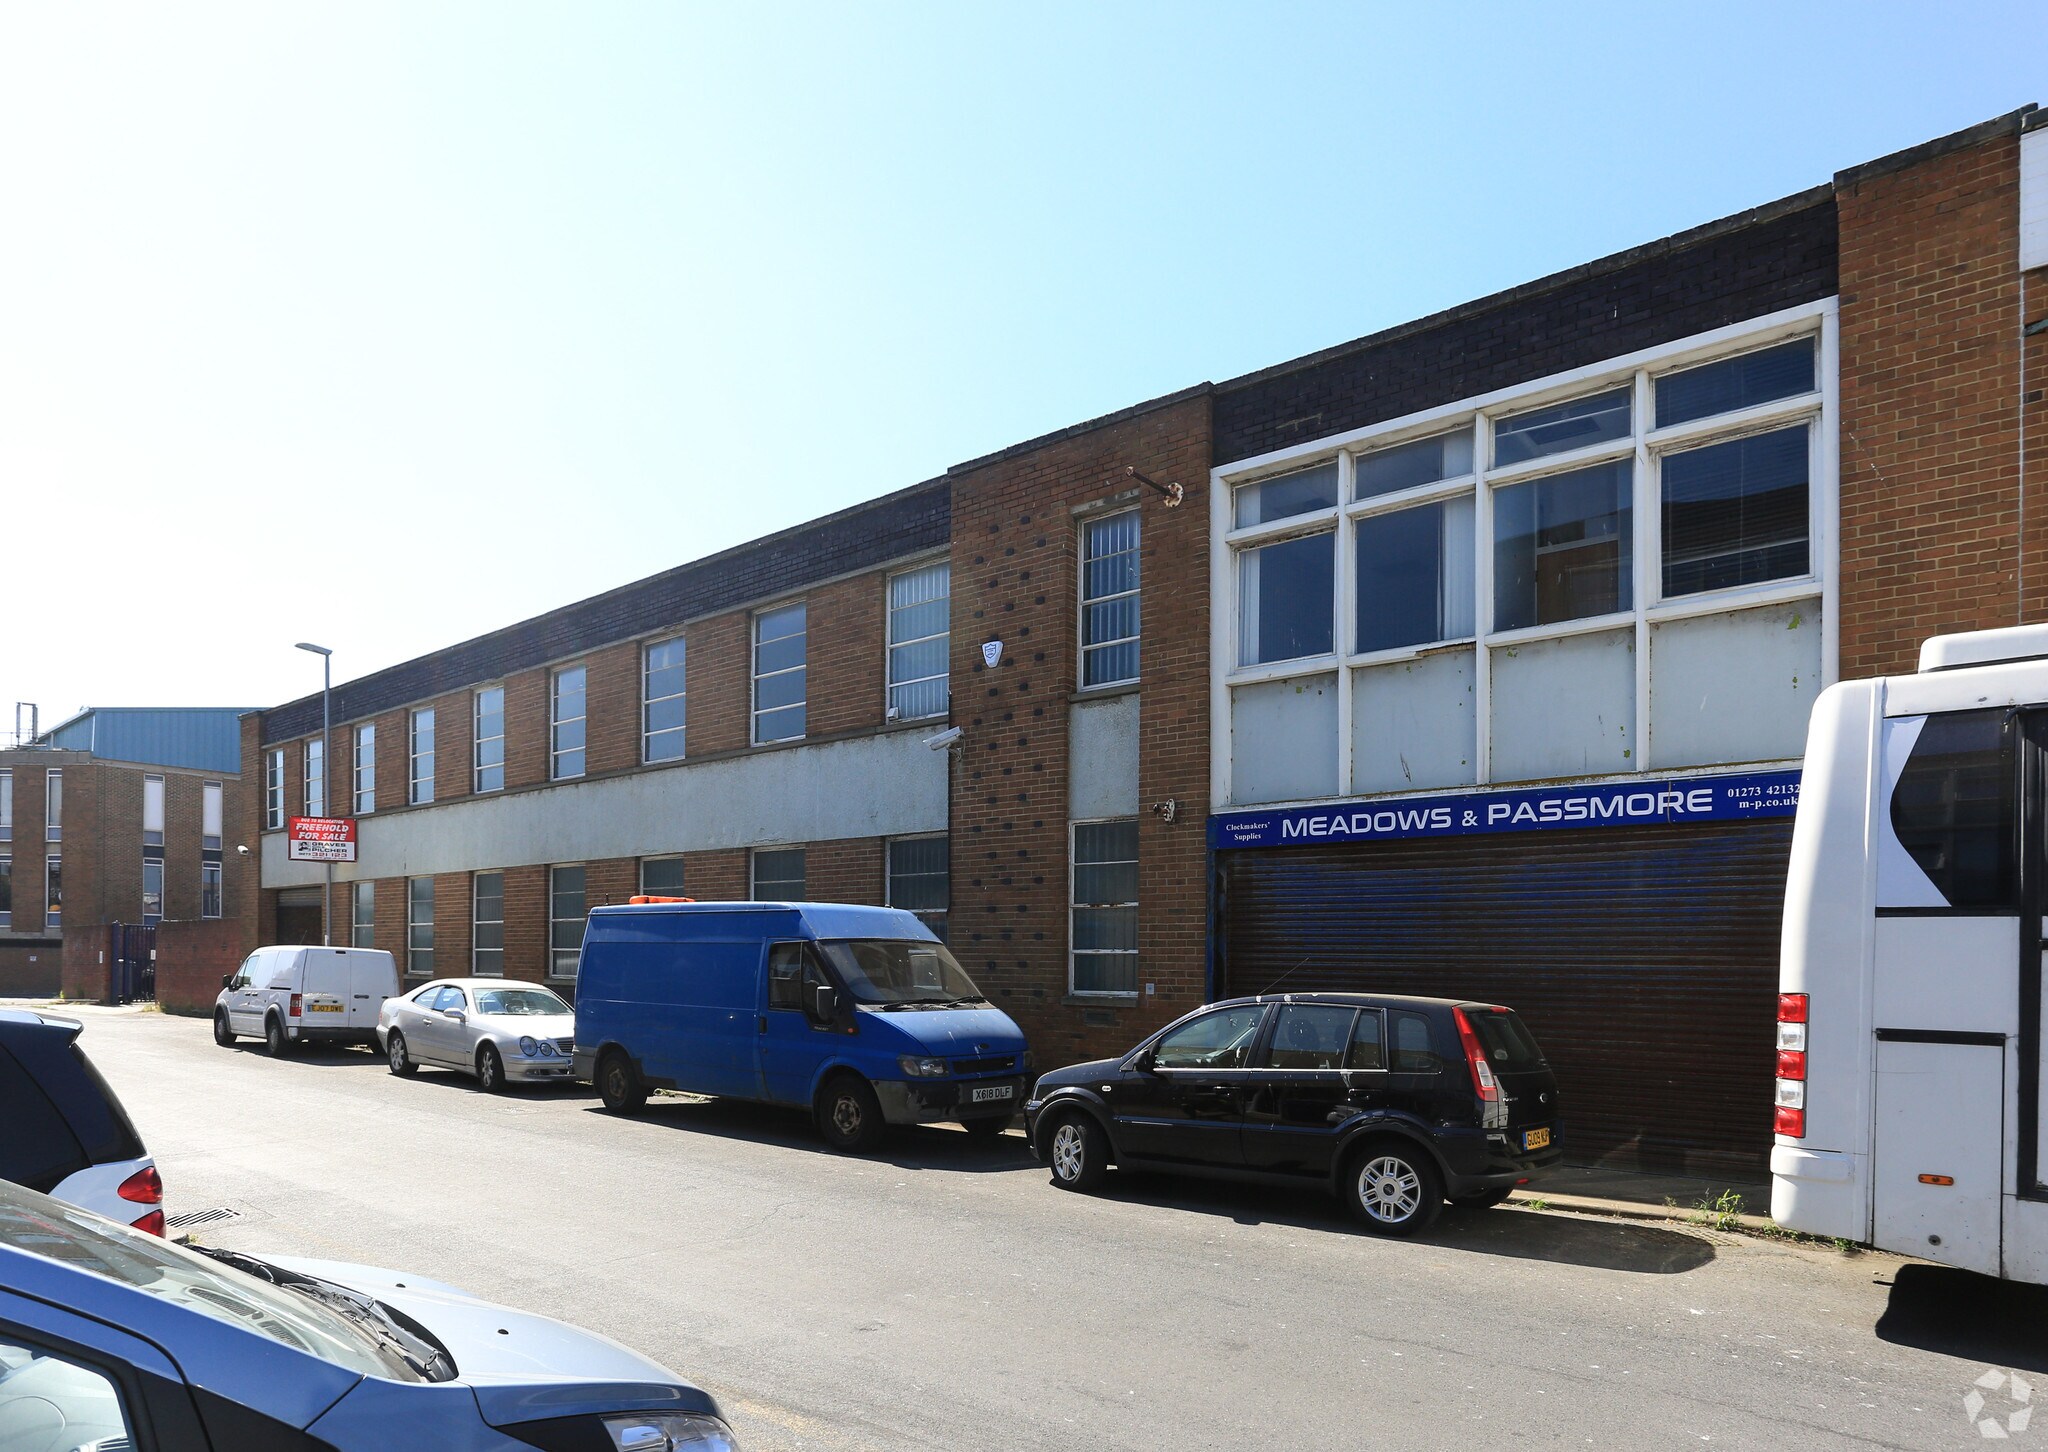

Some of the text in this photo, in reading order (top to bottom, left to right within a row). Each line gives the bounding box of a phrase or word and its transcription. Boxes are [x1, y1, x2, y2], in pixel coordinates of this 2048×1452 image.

[1727, 784, 1800, 797] 01273 42132
[1739, 796, 1798, 809] m-p.co.uk
[1282, 788, 1713, 838] MEADOWS & PASSMORE
[295, 823, 349, 832] FREEHOLD
[1225, 821, 1270, 831] Clockmakers'
[298, 832, 347, 841] FOR SALE
[1234, 832, 1261, 841] Supplies
[976, 1087, 1010, 1100] X618 DLF
